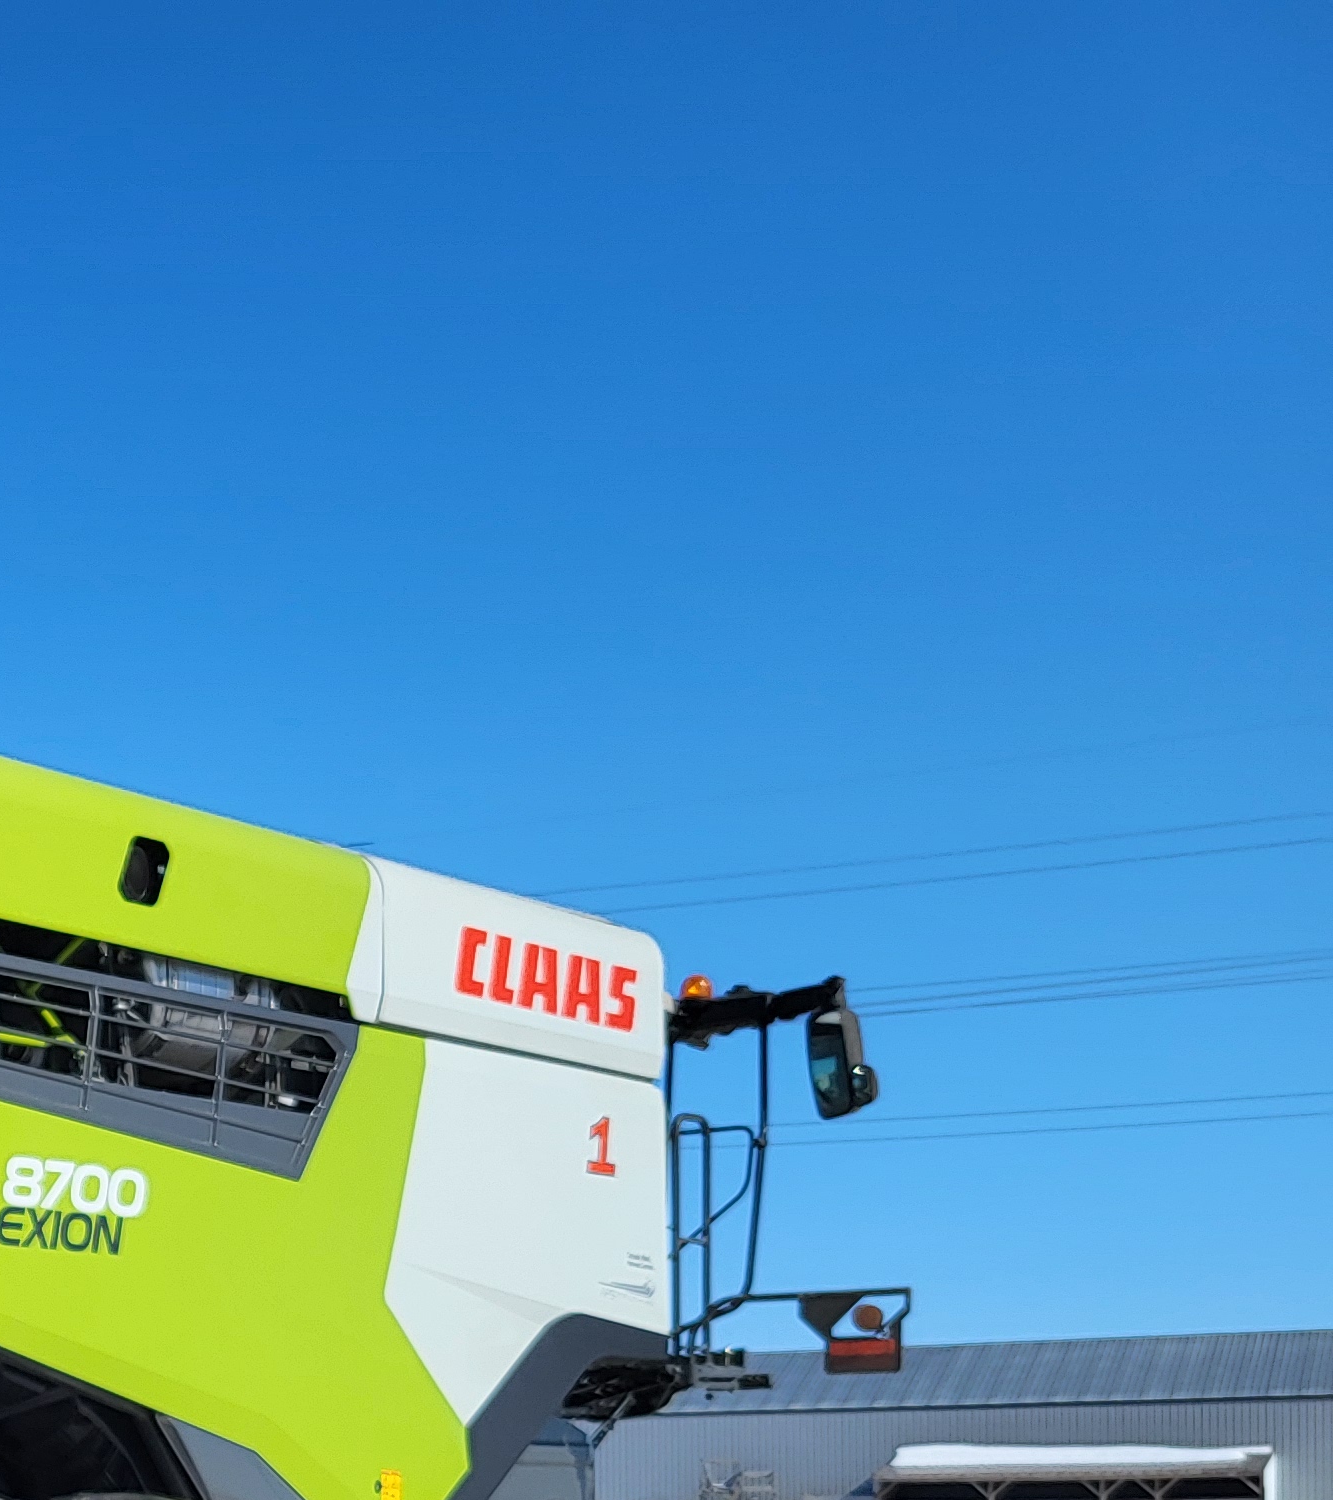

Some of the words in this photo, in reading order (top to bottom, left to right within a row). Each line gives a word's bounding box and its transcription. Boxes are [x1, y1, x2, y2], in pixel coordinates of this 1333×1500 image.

[454, 925, 638, 1033] CLAAS
[586, 1116, 616, 1177] 1
[2, 1155, 145, 1217] 8700
